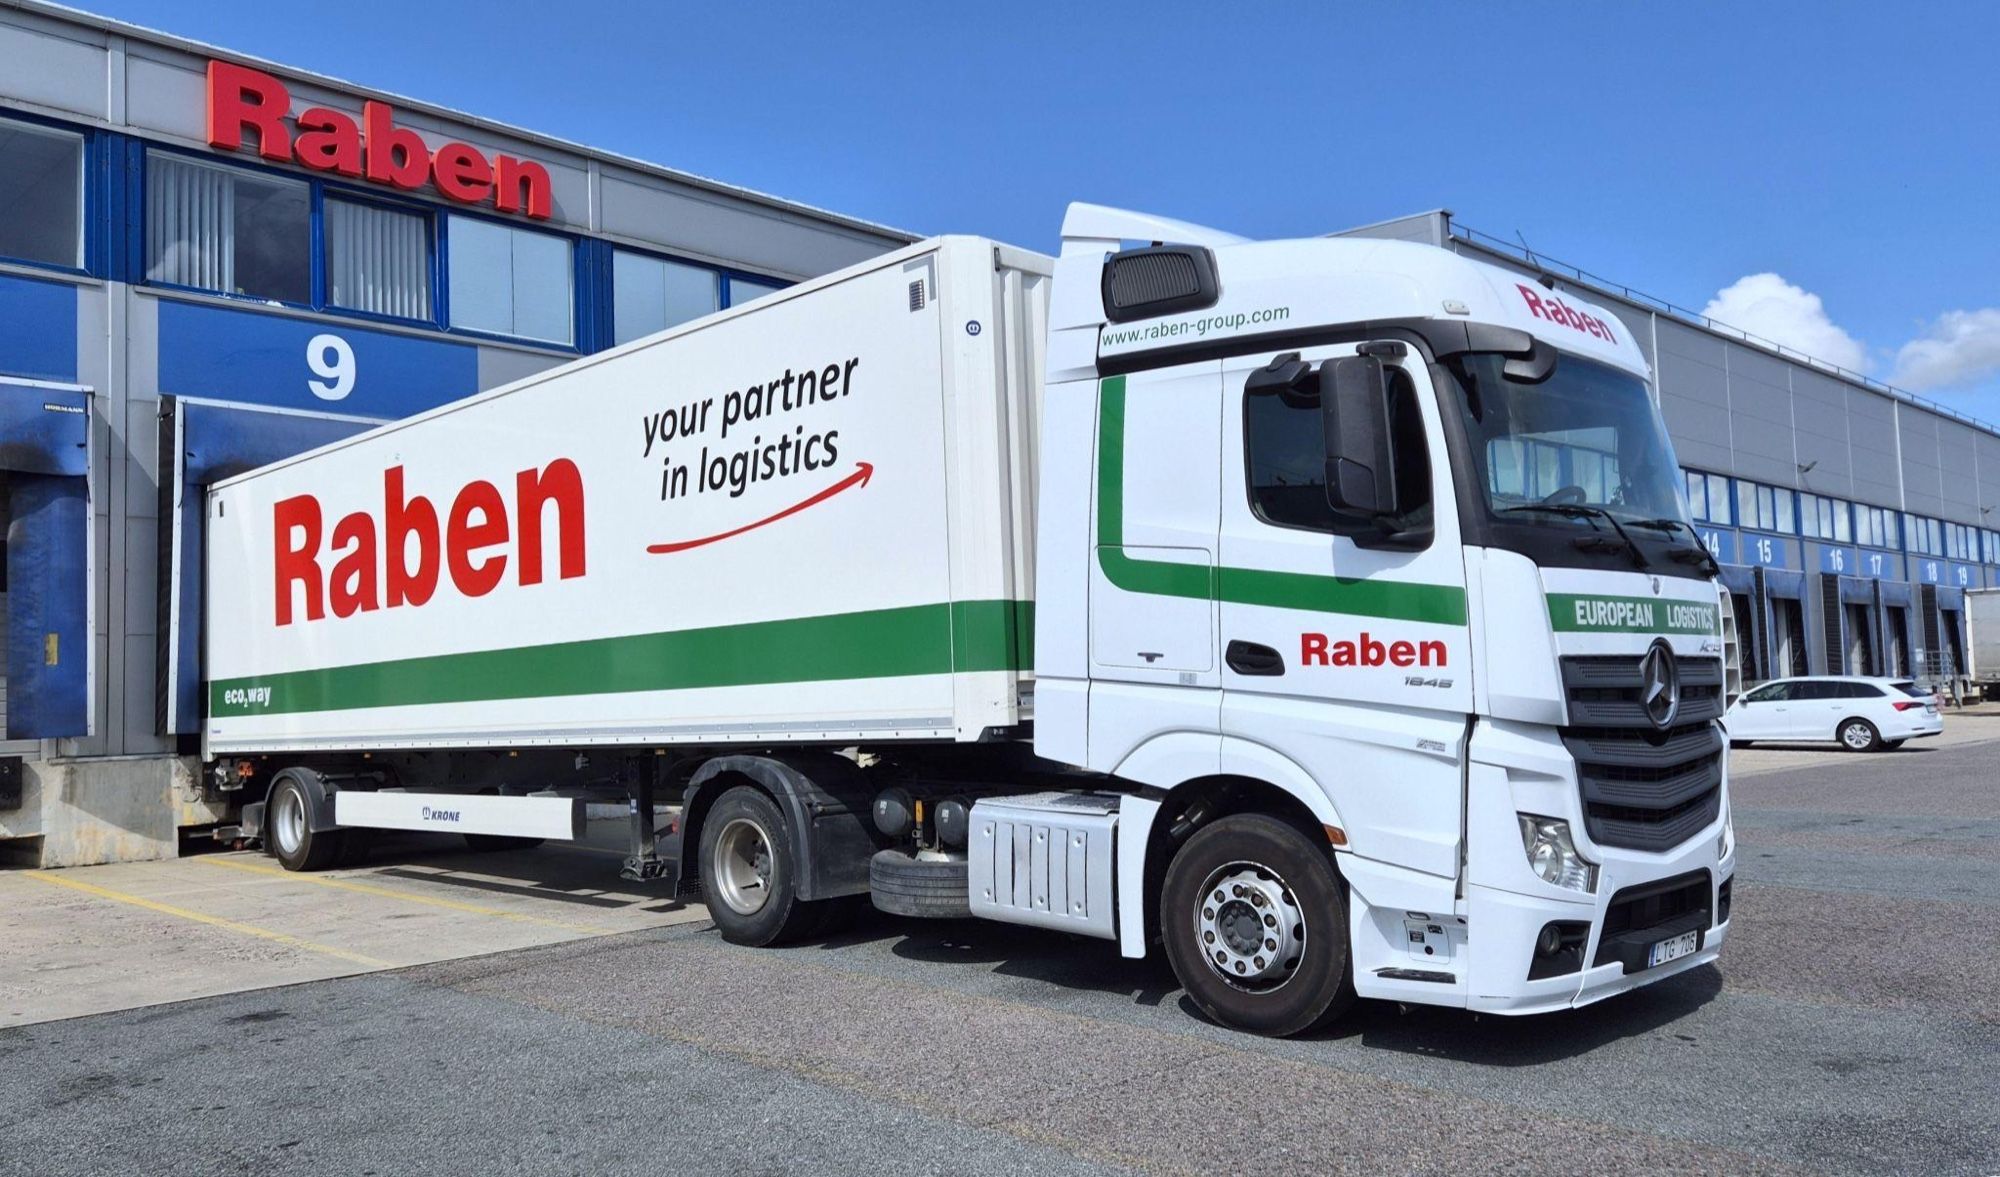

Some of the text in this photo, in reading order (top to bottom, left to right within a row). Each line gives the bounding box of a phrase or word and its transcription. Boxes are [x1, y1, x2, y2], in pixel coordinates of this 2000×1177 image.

[207, 59, 552, 220] Raben
[1102, 306, 1290, 346] www.raben-group.com
[1515, 283, 1618, 345] Raben
[306, 333, 356, 401] 9
[643, 357, 859, 458] your partner
[661, 425, 839, 500] in logistics
[274, 457, 586, 627] Raben
[1703, 532, 1720, 558] 14
[1757, 539, 1772, 563] 15
[1830, 549, 1843, 571] 16
[1870, 554, 1882, 575] 17
[1927, 561, 1938, 581] 18
[1958, 566, 1968, 585] 19
[1575, 600, 1714, 629] EUROPEAN LOGISTICS
[1301, 632, 1448, 667] Raben
[431, 810, 461, 821] KRONE
[1656, 940, 1676, 964] LTG
